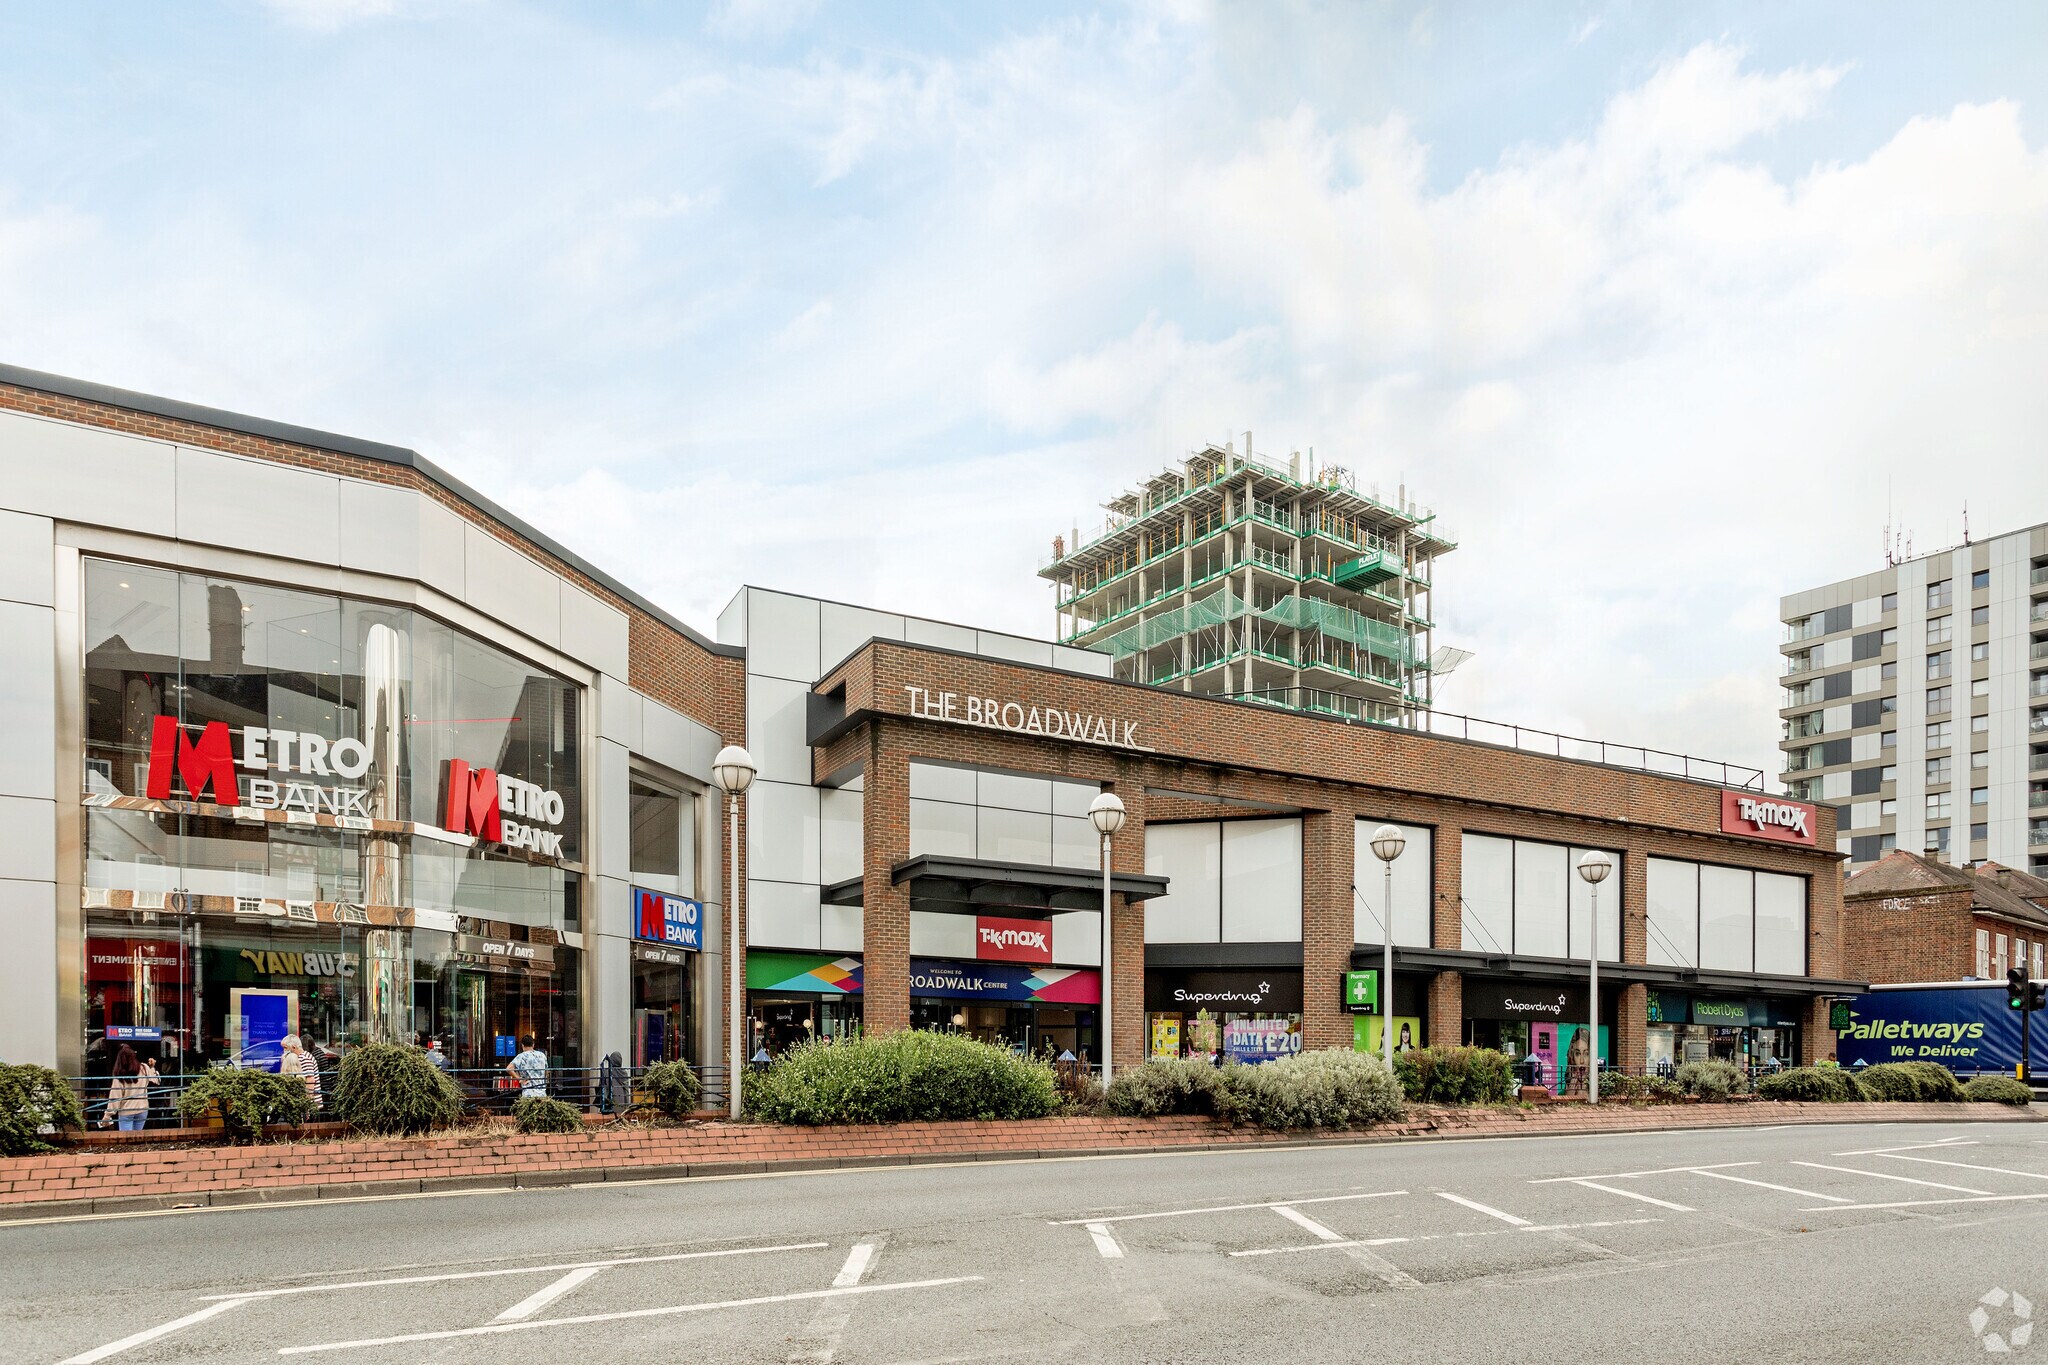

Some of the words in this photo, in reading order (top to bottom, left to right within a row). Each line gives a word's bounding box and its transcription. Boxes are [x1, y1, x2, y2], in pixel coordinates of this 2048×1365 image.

[905, 686, 958, 722] THE
[968, 696, 1138, 749] BROADWALK
[147, 715, 371, 806] METRO
[249, 779, 369, 818] BANK
[446, 758, 564, 843] METRO
[501, 819, 564, 859] BANK
[640, 893, 697, 940] METRO
[666, 924, 697, 945] BANK
[482, 943, 505, 955] OPEN
[506, 942, 514, 956] 7
[515, 948, 534, 958] DAYS
[645, 951, 660, 960] OPEN
[661, 950, 667, 961] 7
[666, 954, 680, 963] DAYS
[909, 975, 983, 991] ROADWALK
[983, 981, 1008, 990] CENTRE
[1174, 989, 1262, 1004] Superdrug
[1504, 998, 1561, 1015] Superdrug
[1697, 1002, 1724, 1016] Robert
[1725, 1004, 1744, 1019] Dyas
[1233, 1019, 1289, 1031] UNLIMITED
[1839, 1020, 1984, 1043] Palletways
[1233, 1032, 1263, 1046] DATA
[1265, 1031, 1301, 1052] £20
[1891, 1045, 1914, 1056] We
[1919, 1045, 1978, 1056] Deliver
